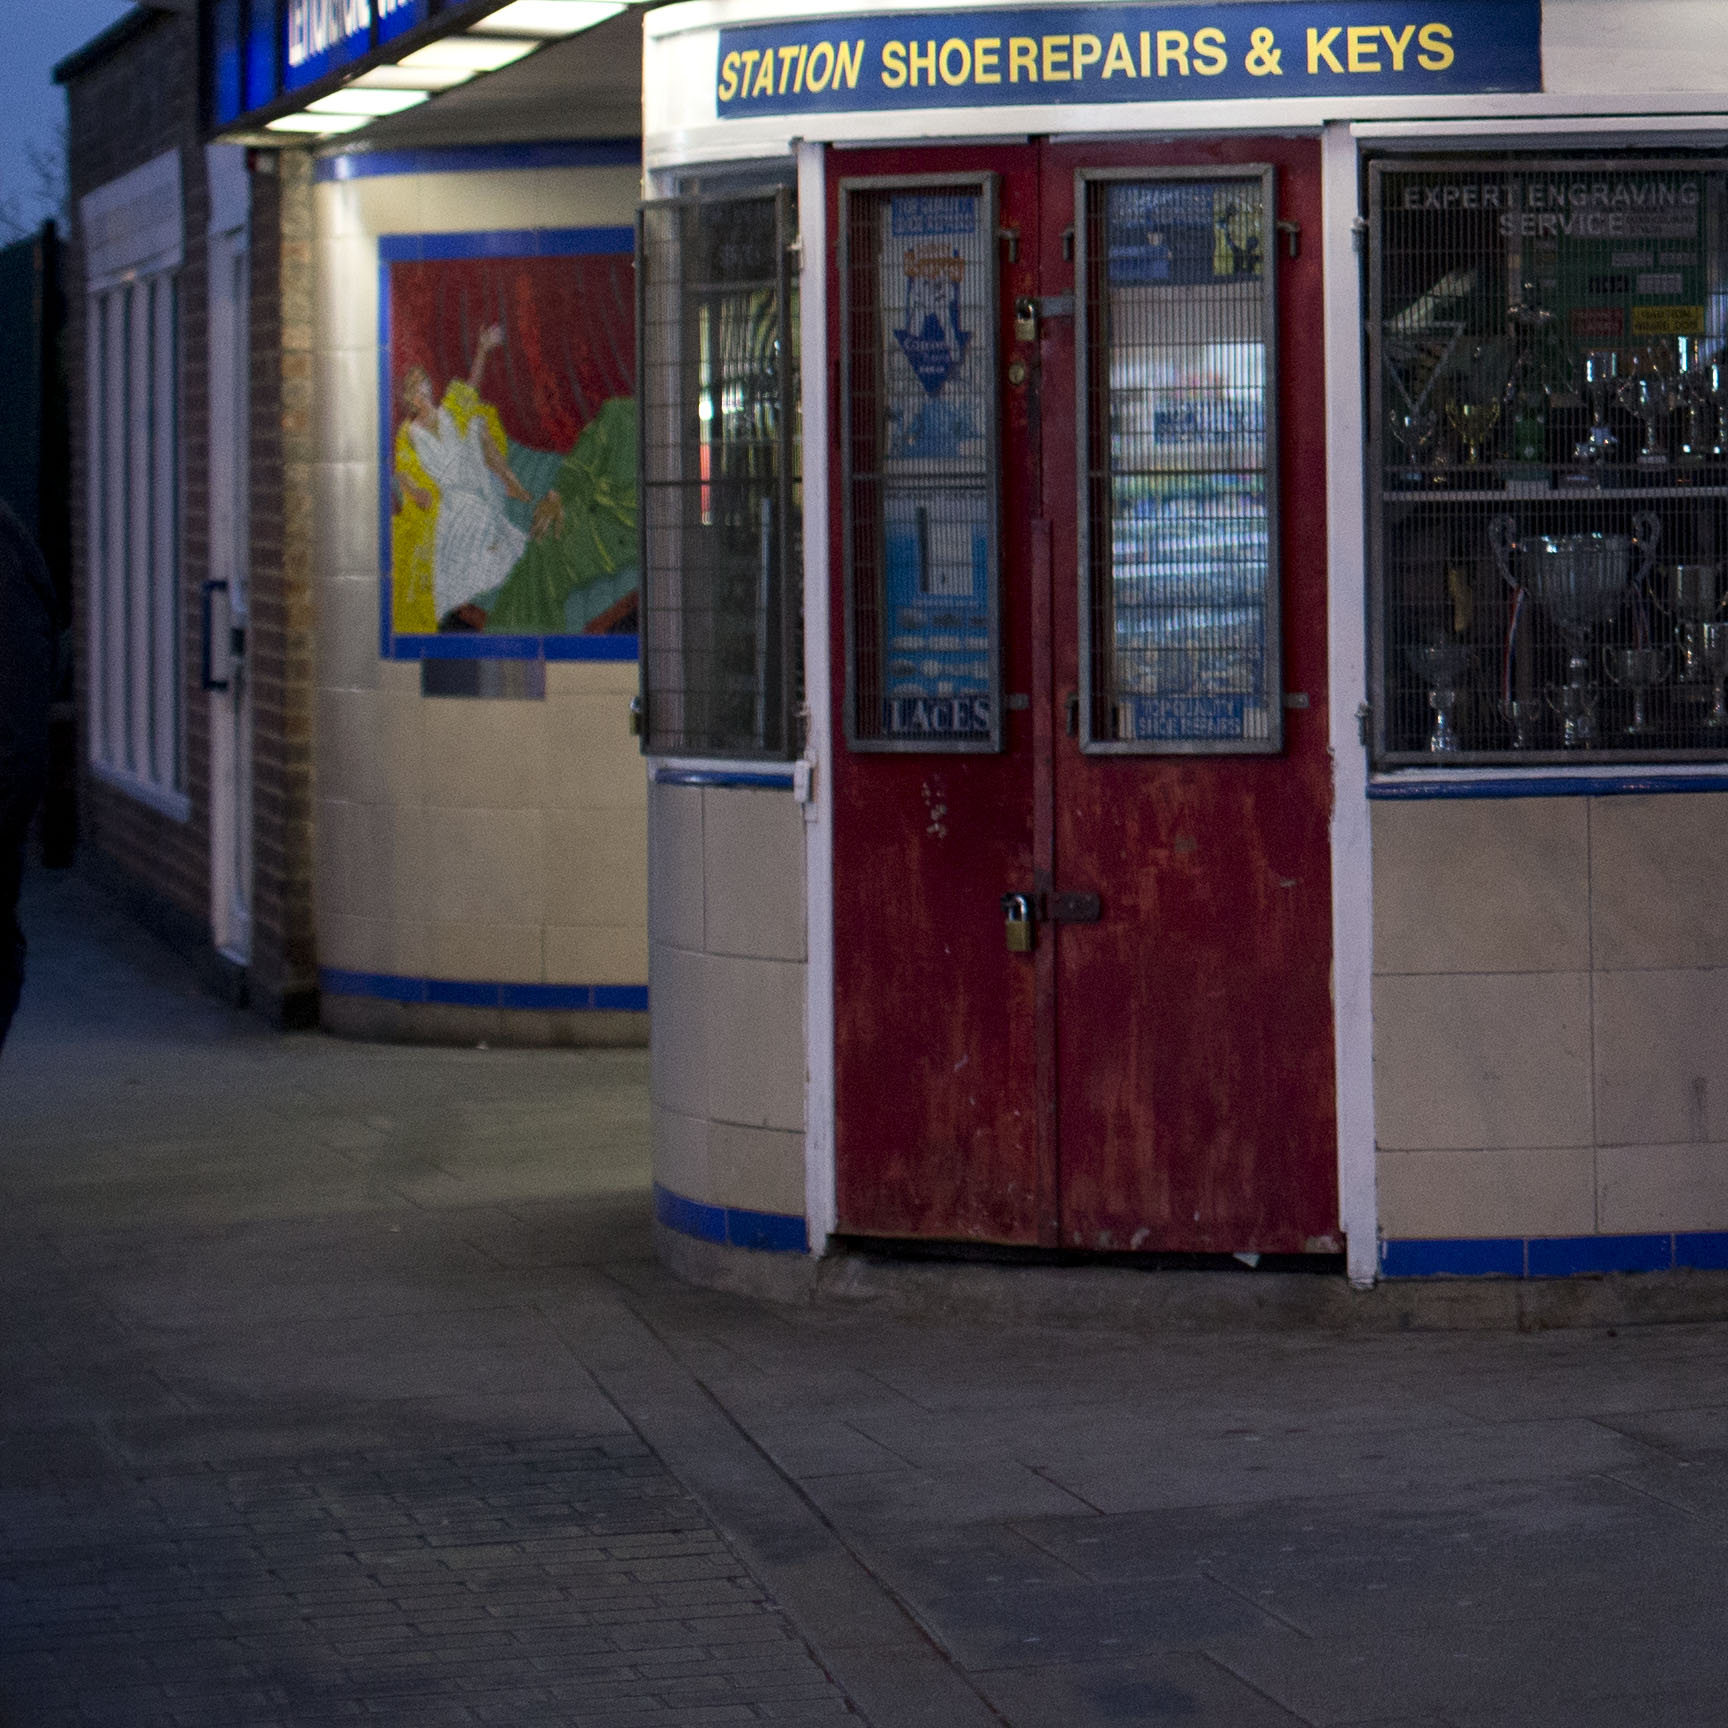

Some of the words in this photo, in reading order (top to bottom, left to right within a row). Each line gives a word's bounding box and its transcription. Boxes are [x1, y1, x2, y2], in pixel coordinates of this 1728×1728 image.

[717, 38, 865, 102] STATION
[1244, 26, 1284, 77] &
[1306, 22, 1455, 75] KEYS
[1403, 184, 1515, 210] EXPERT
[1528, 182, 1699, 208] ENGRAVING
[1500, 212, 1624, 237] SERVICE
[890, 697, 990, 733] LACES
